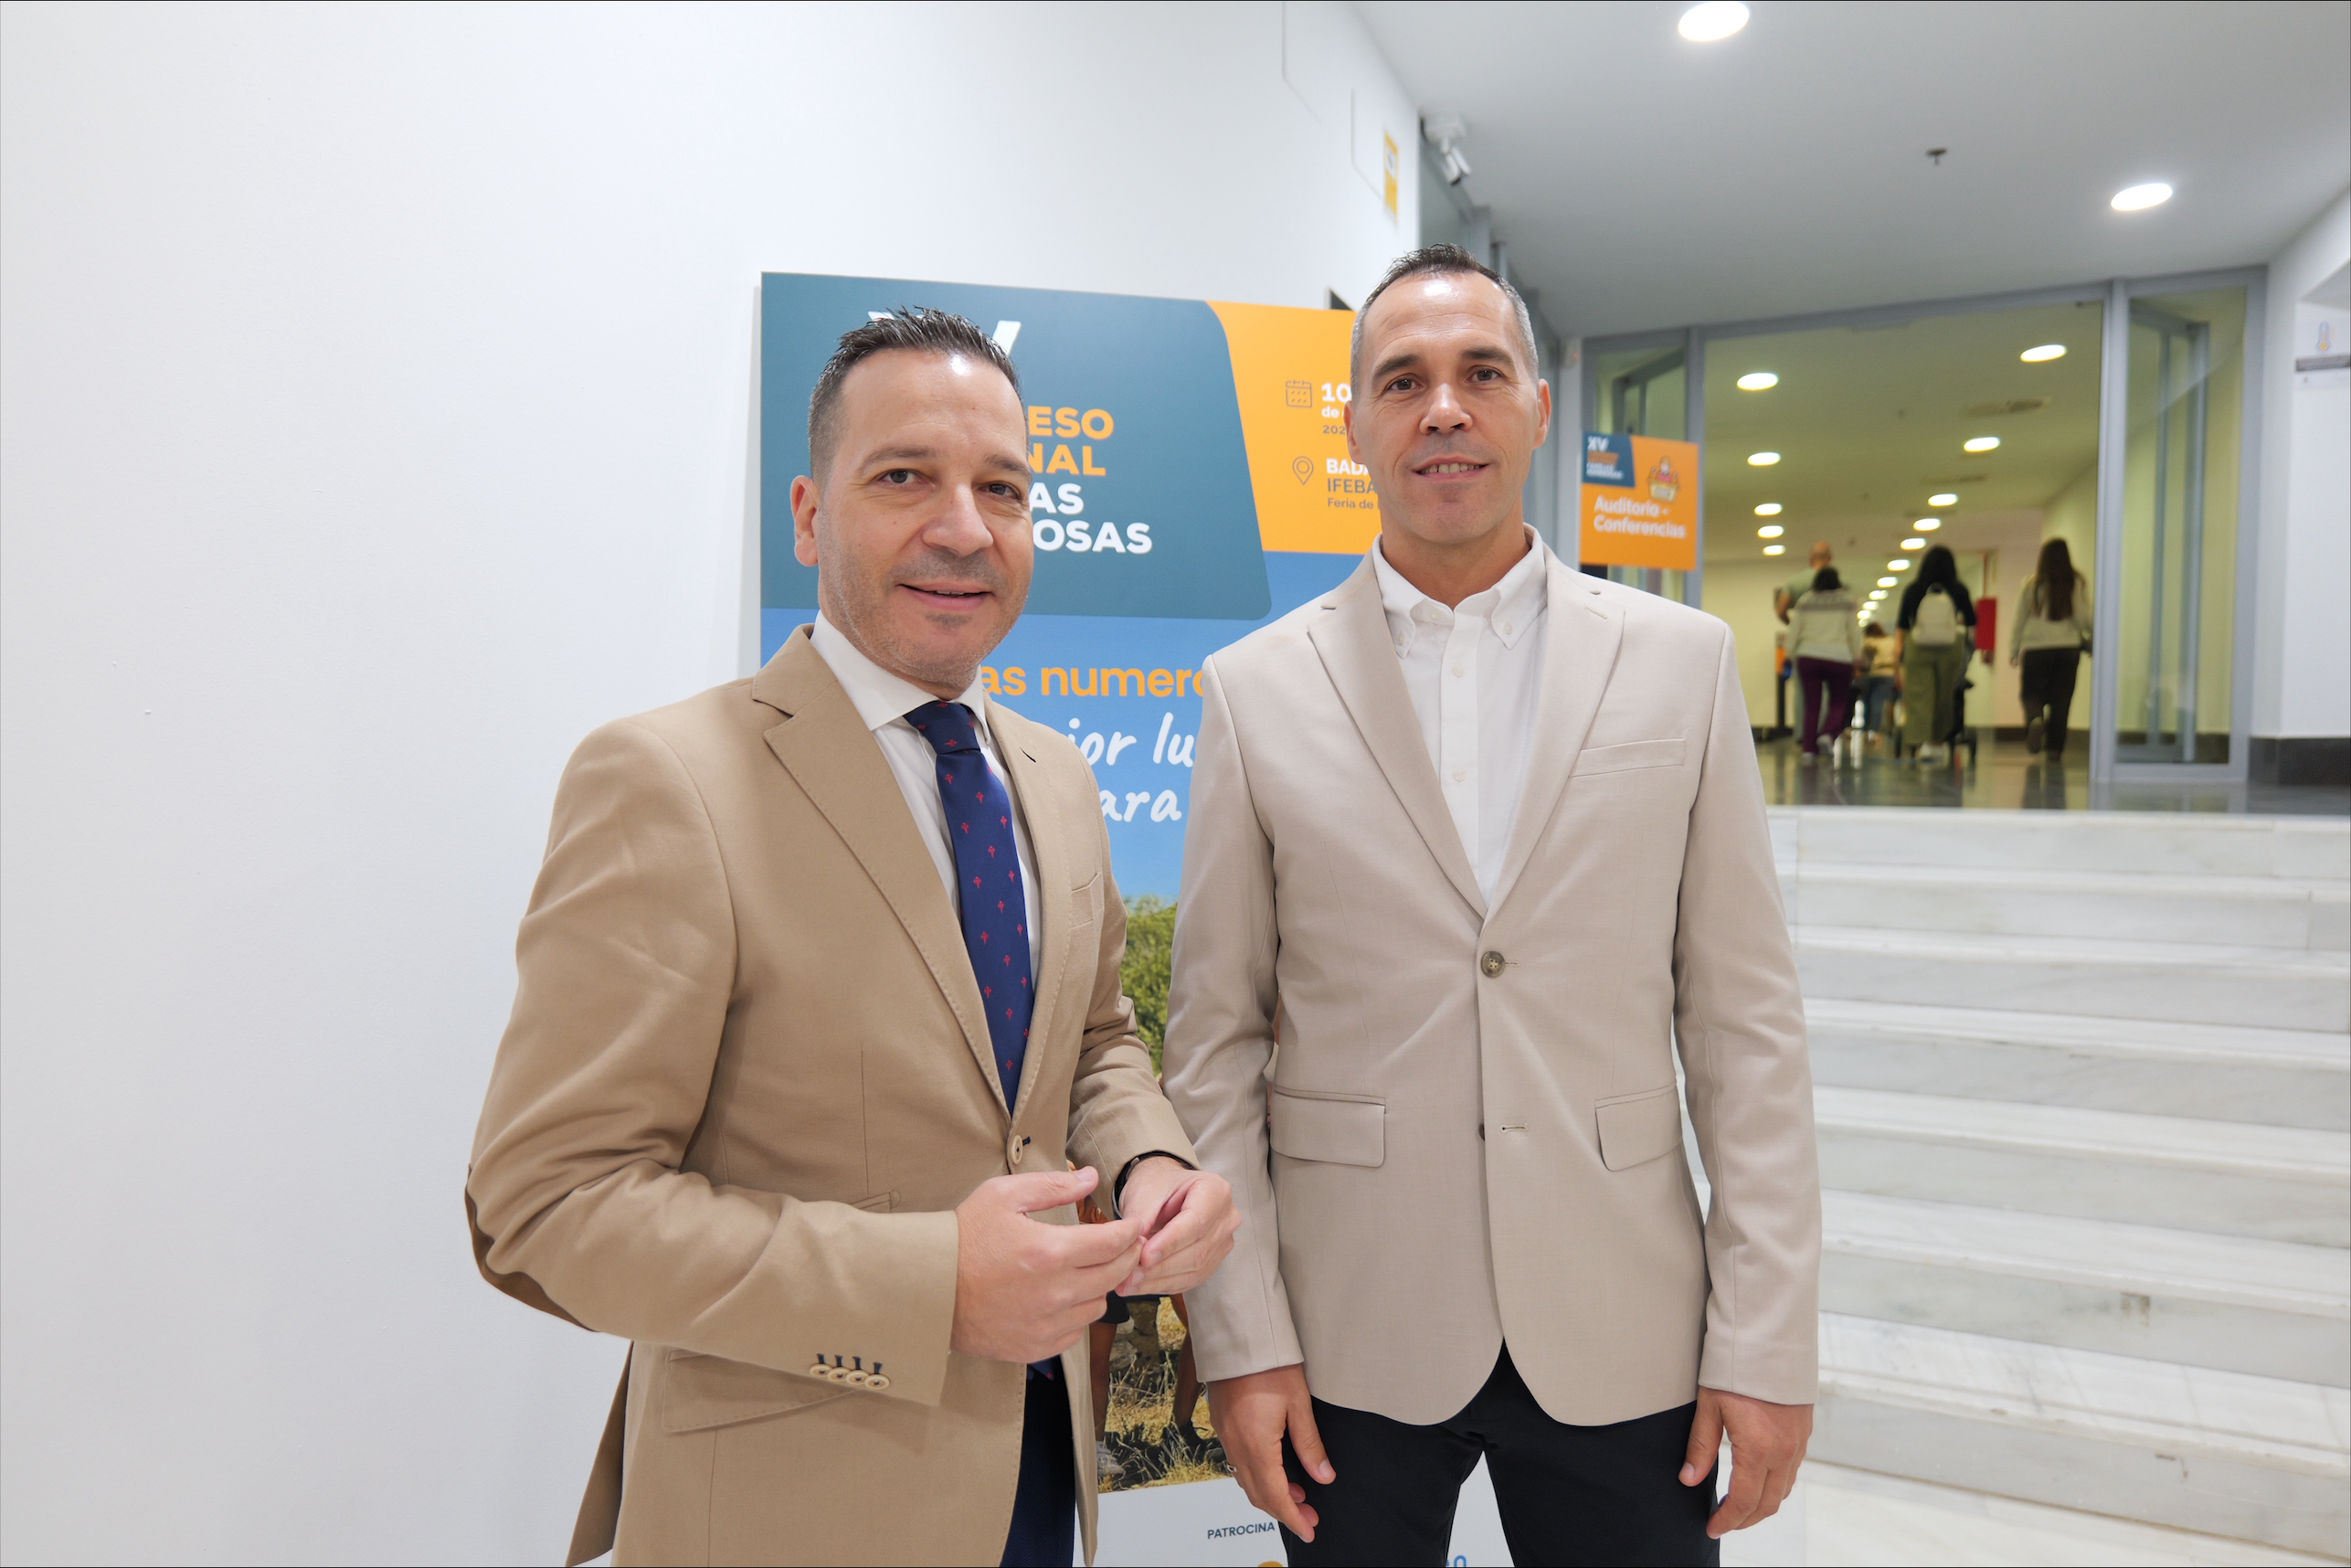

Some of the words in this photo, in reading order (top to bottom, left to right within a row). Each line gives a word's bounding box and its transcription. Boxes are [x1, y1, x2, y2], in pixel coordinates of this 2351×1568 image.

[1321, 405, 1340, 418] de
[1587, 435, 1609, 452] XV
[1328, 497, 1356, 509] Feria
[1359, 499, 1374, 509] de
[1594, 494, 1660, 518] Auditorio
[1594, 514, 1686, 538] Conferencias
[1207, 1521, 1276, 1540] PATROCINA
